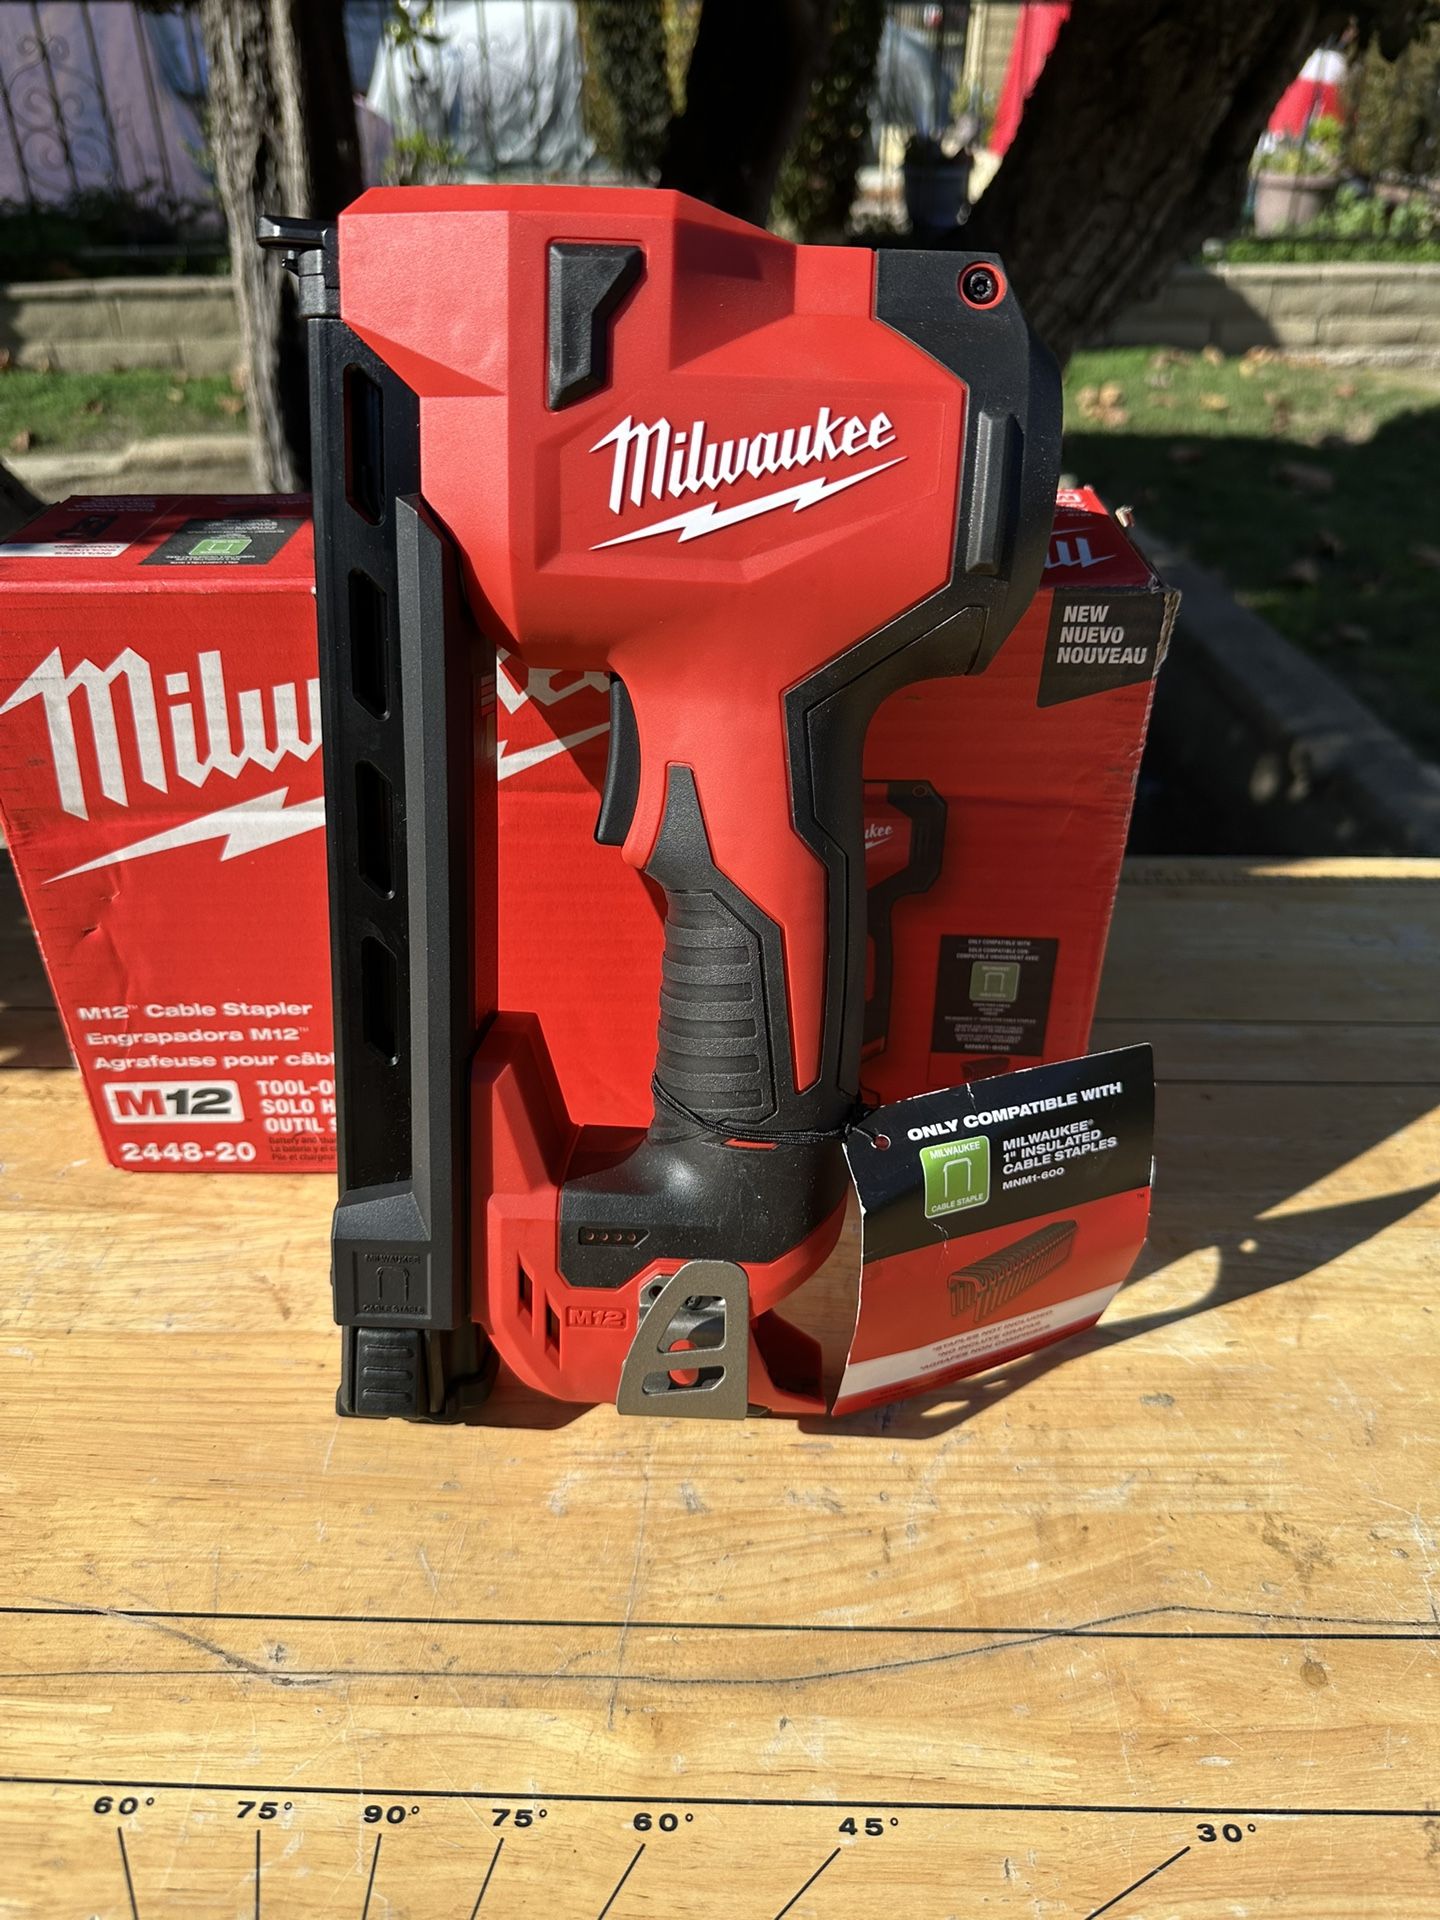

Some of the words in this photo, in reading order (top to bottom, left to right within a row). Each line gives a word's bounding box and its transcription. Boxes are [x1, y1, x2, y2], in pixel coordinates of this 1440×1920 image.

[589, 406, 896, 515] Milwaukee
[1063, 605, 1109, 623] NEW
[1060, 626, 1124, 644] NUEVO
[1057, 647, 1147, 664] NOUVEAU
[145, 1003, 216, 1018] Cable
[223, 1002, 312, 1018] Stapler
[87, 1029, 243, 1047] Engrapadora
[95, 1055, 217, 1072] Agrafeuse
[223, 1055, 278, 1069] pour
[256, 1079, 335, 1096] TOOL-O
[113, 1088, 234, 1117] M12
[261, 1099, 315, 1115] SOLO
[907, 1119, 958, 1141] ONLY
[963, 1093, 1078, 1128] COMPATIBLE
[1081, 1082, 1123, 1101] WITH
[264, 1117, 325, 1133] OUTIL
[121, 1141, 256, 1163] 2448-20
[929, 1141, 981, 1160] MILWAUKEE
[1021, 1129, 1101, 1158] INSULATED
[1002, 1154, 1051, 1175] CABLE
[1054, 1137, 1118, 1162] STAPLES
[1002, 1167, 1064, 1190] MNM1-600
[931, 1200, 956, 1213] CABLE
[956, 1193, 984, 1206] STAPLE
[568, 1309, 624, 1325] M12
[94, 1796, 155, 1815] 60°
[237, 1801, 293, 1819] 75°
[363, 1805, 420, 1824] 90°
[491, 1809, 547, 1827] 75°
[633, 1812, 693, 1832] 60°
[838, 1817, 899, 1836] 45°
[1196, 1823, 1256, 1843] 30°
